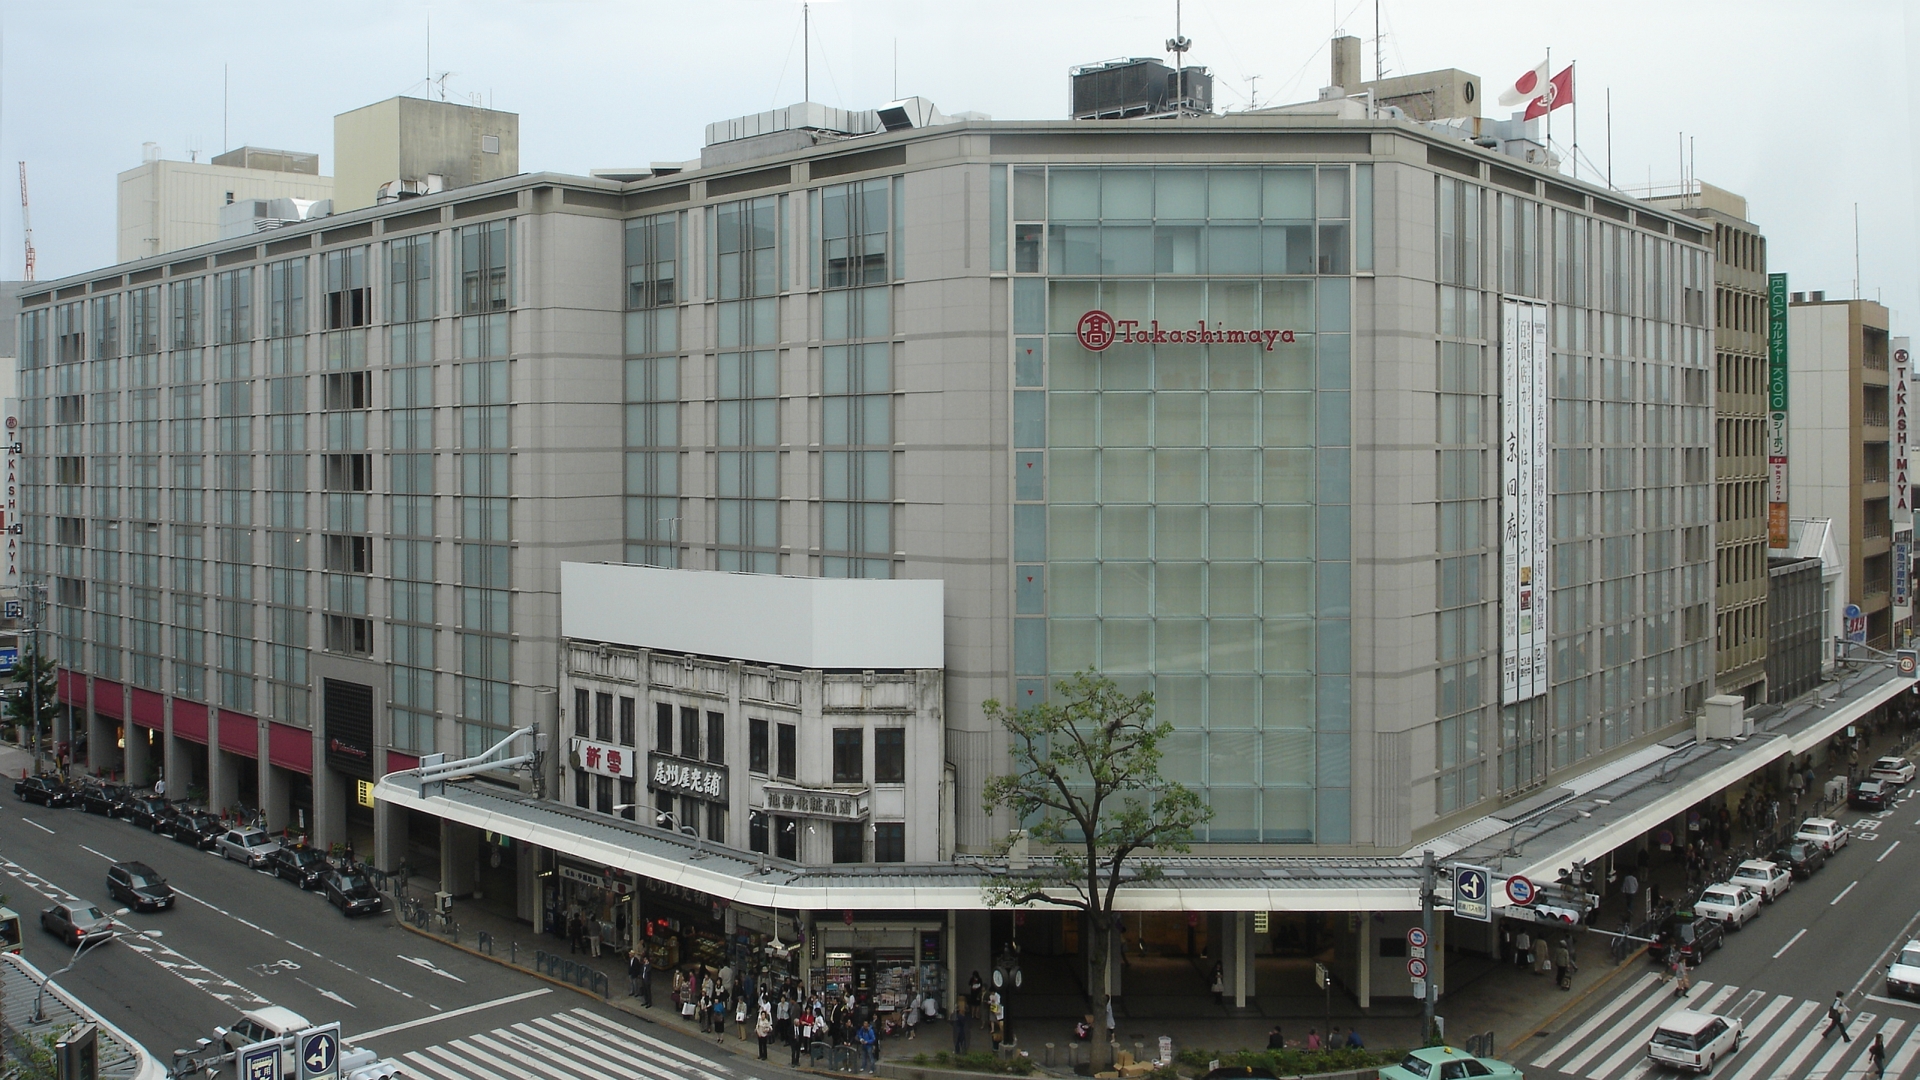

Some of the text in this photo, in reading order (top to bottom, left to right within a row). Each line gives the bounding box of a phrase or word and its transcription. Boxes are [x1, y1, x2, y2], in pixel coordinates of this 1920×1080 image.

[1117, 319, 1296, 351] Takashimaya
[1772, 321, 1784, 363] カルチャー
[1772, 367, 1784, 408] KYOTO
[1896, 367, 1908, 509] TAKASHIMAYA
[8, 431, 16, 575] TAKASHIMAYA
[586, 745, 622, 774] 新雪
[653, 760, 722, 796] 尾州屋老舗
